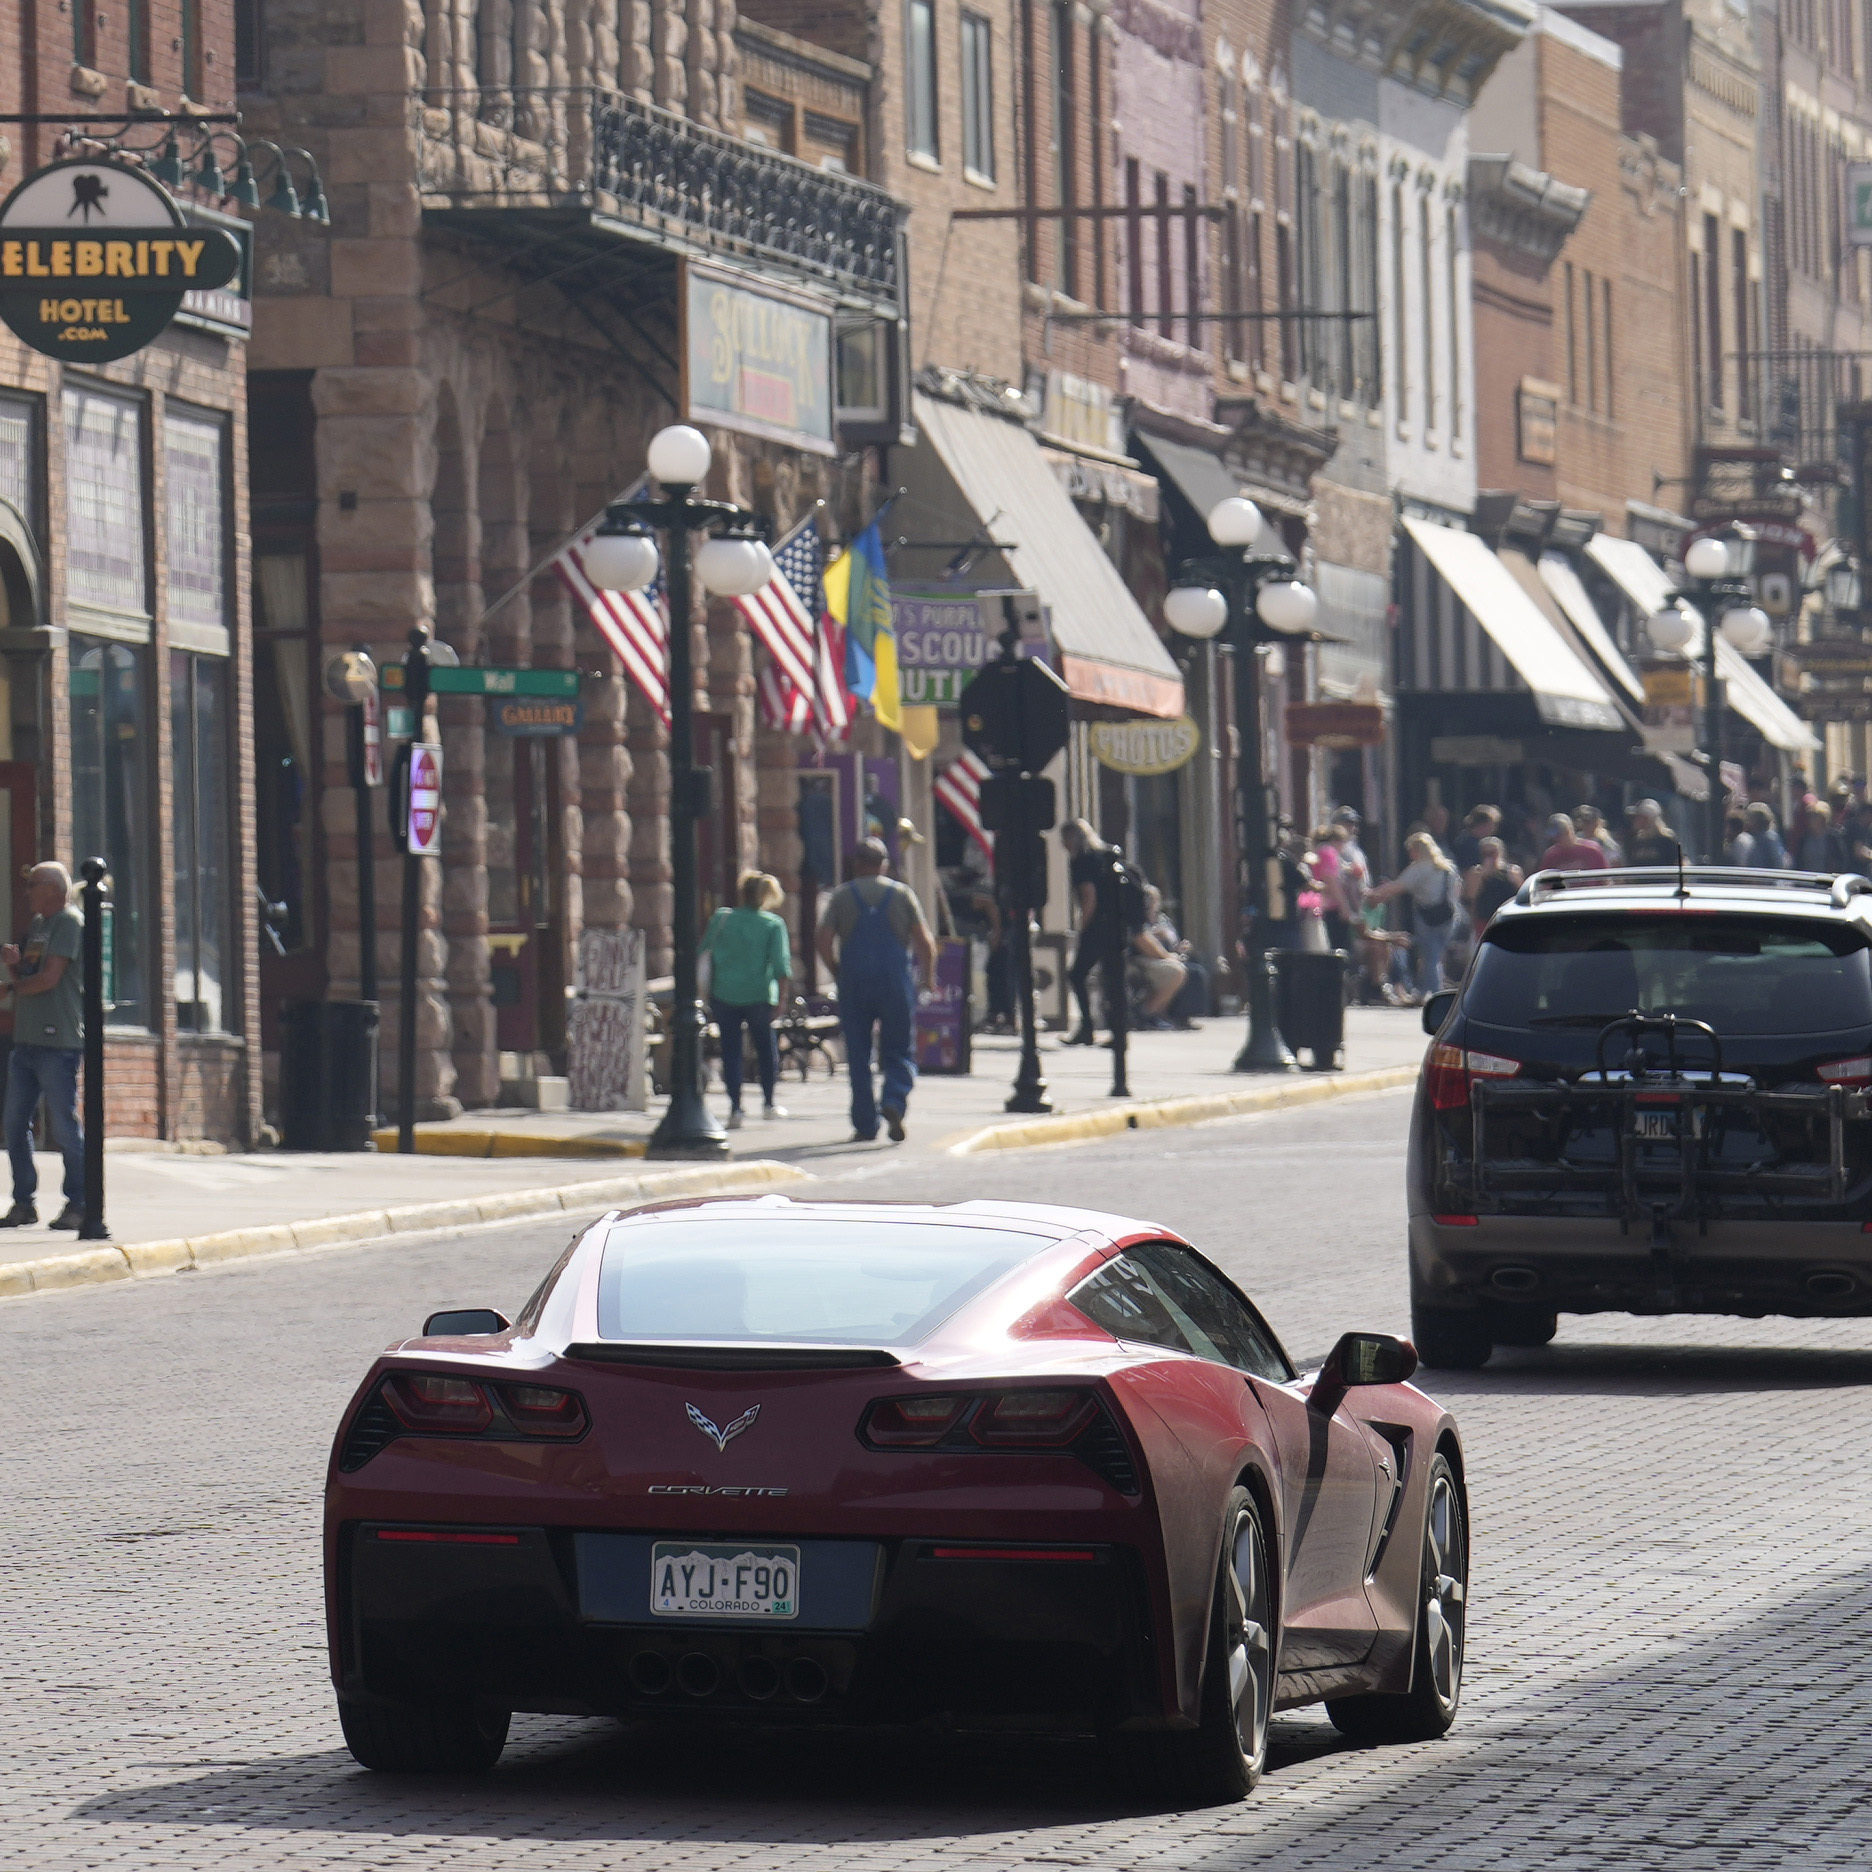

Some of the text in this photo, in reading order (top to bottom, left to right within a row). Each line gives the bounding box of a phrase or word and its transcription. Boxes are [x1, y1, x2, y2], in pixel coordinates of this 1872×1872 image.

[39, 298, 131, 324] HOTEL
[58, 327, 108, 341] .COM
[484, 670, 516, 692] Wall
[1097, 724, 1192, 766] PHOTOS
[647, 1485, 789, 1497] CORVETTE
[689, 1599, 761, 1612] COLORADO
[774, 1602, 787, 1611] 24
